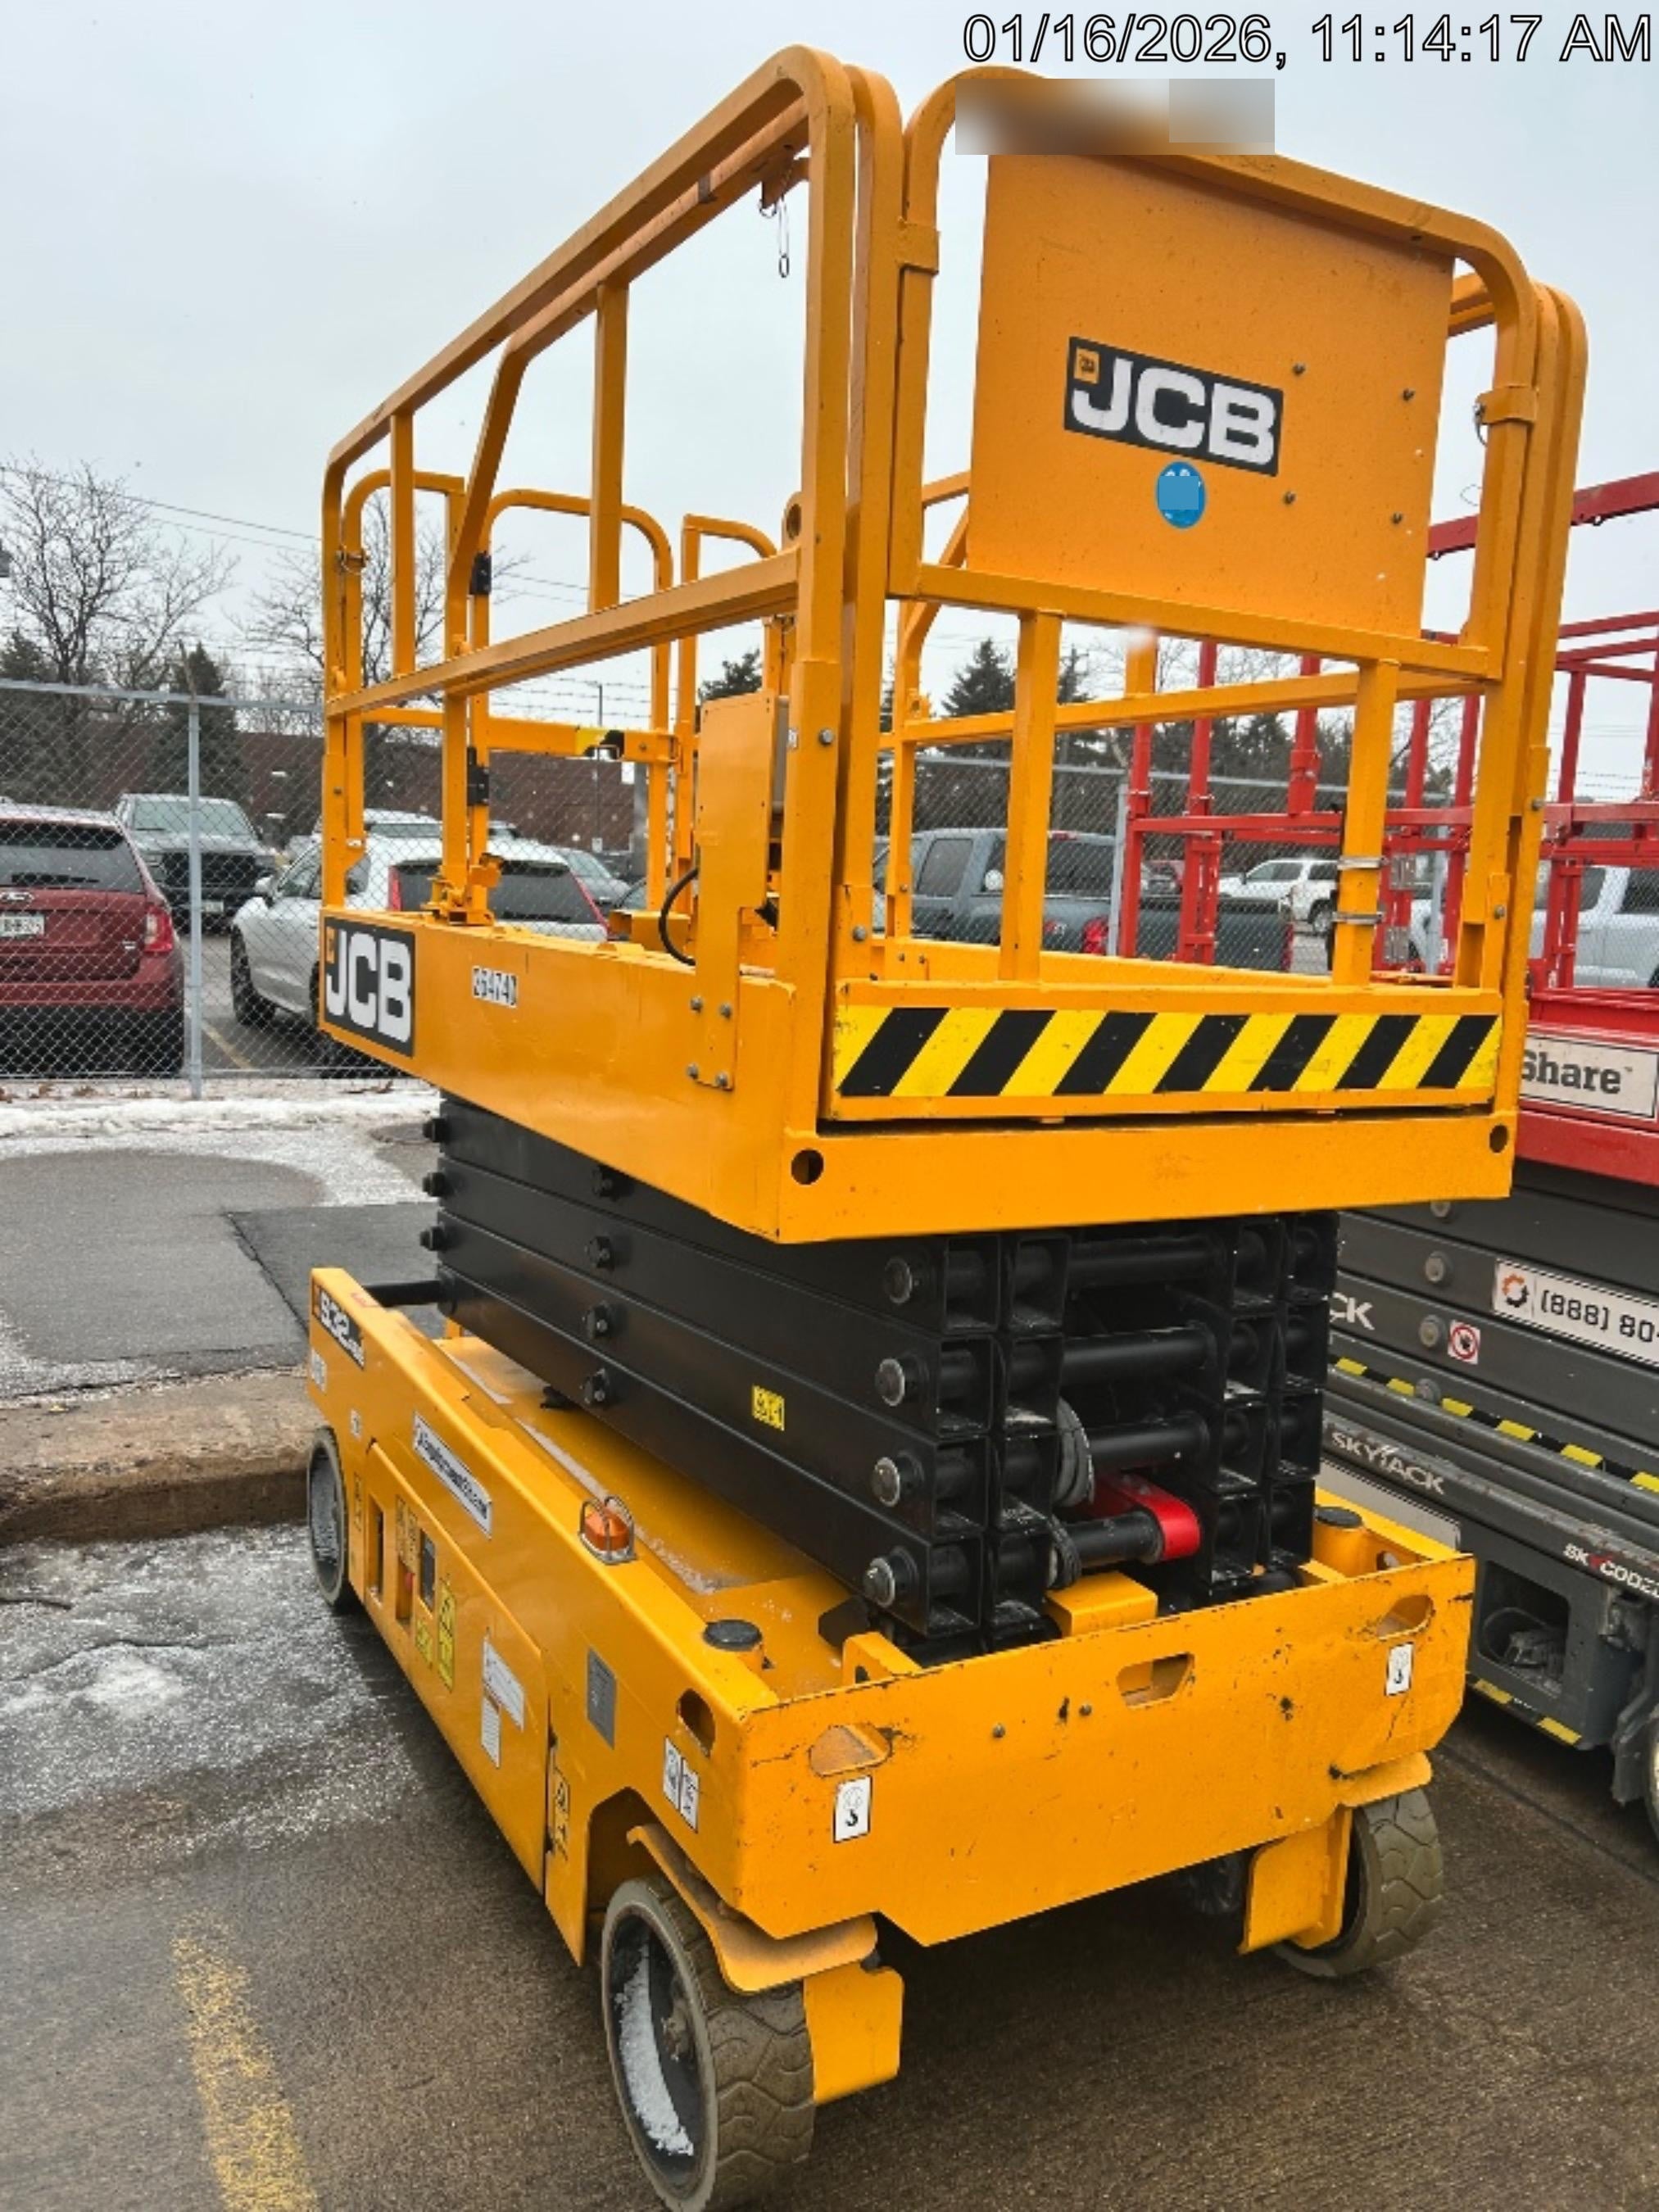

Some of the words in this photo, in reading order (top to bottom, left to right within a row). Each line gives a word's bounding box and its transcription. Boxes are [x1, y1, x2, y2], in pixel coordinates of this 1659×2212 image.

[1072, 357, 1276, 465] JCB
[326, 928, 411, 1044] JCB
[1541, 1290, 1609, 1330] (888)
[1620, 1315, 1659, 1342] 80
[1331, 1432, 1445, 1495] SKYJACK
